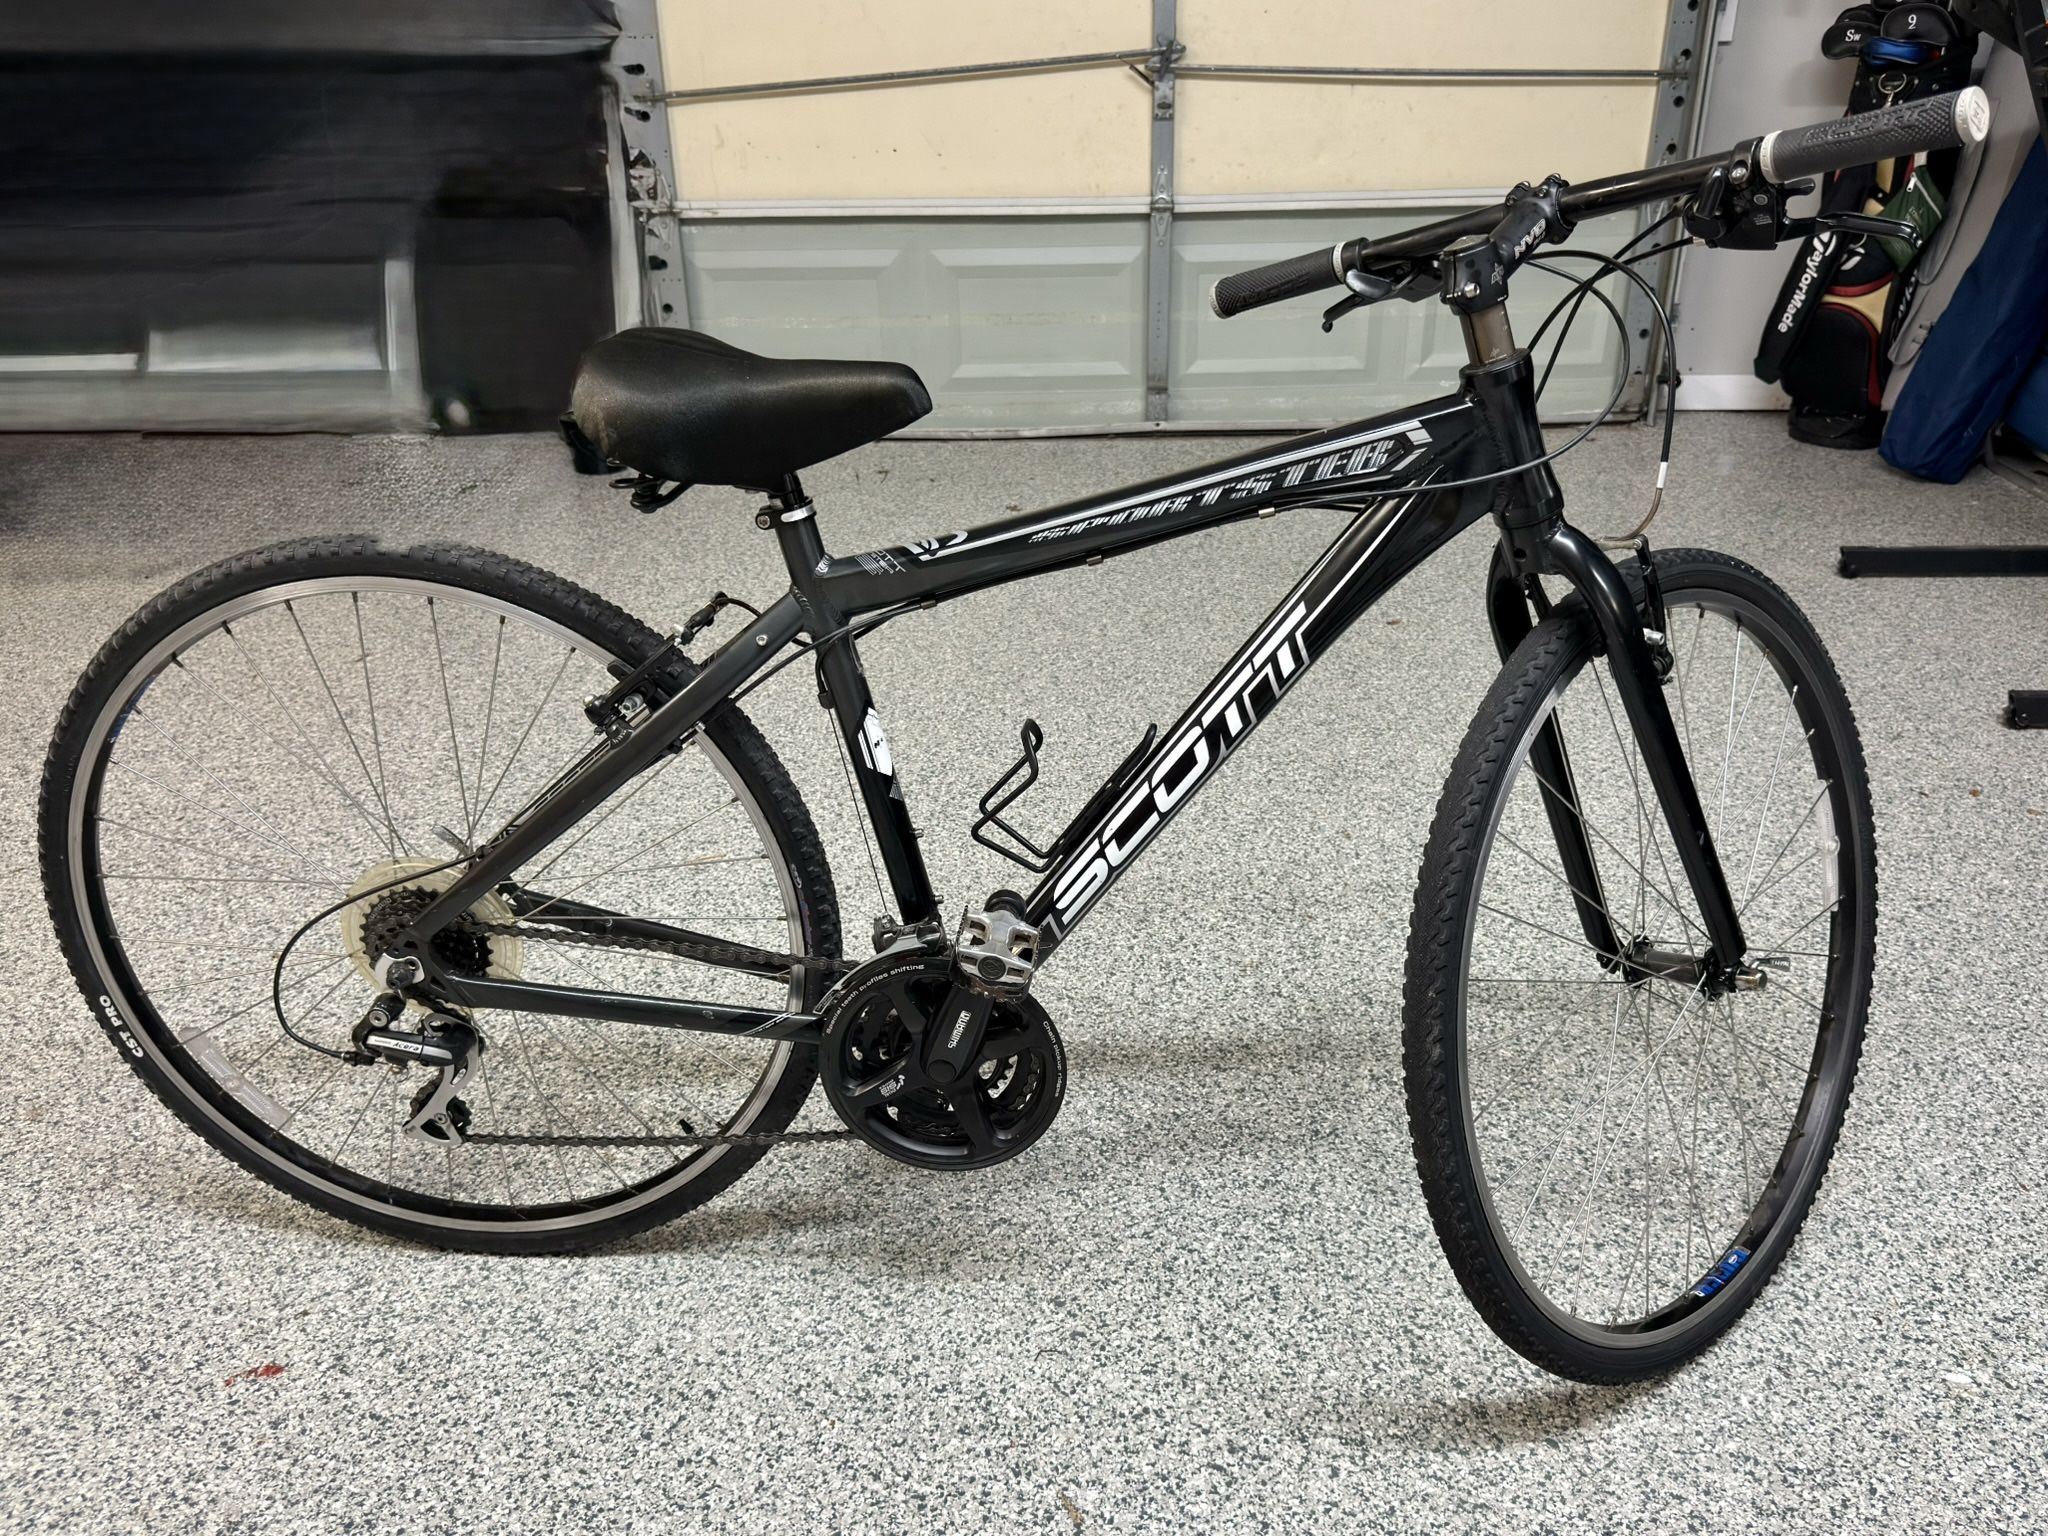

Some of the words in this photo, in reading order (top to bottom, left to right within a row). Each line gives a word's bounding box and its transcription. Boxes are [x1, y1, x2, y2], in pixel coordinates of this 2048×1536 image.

[1908, 14, 1917, 29] 9
[1778, 231, 1837, 333] TaylorMade
[1053, 601, 1307, 926] SCOTT
[890, 964, 925, 976] shifting
[100, 995, 123, 1027] PRO
[948, 1010, 972, 1049] SHIMANO
[1043, 1020, 1056, 1044] Chain
[119, 1031, 144, 1058] CST
